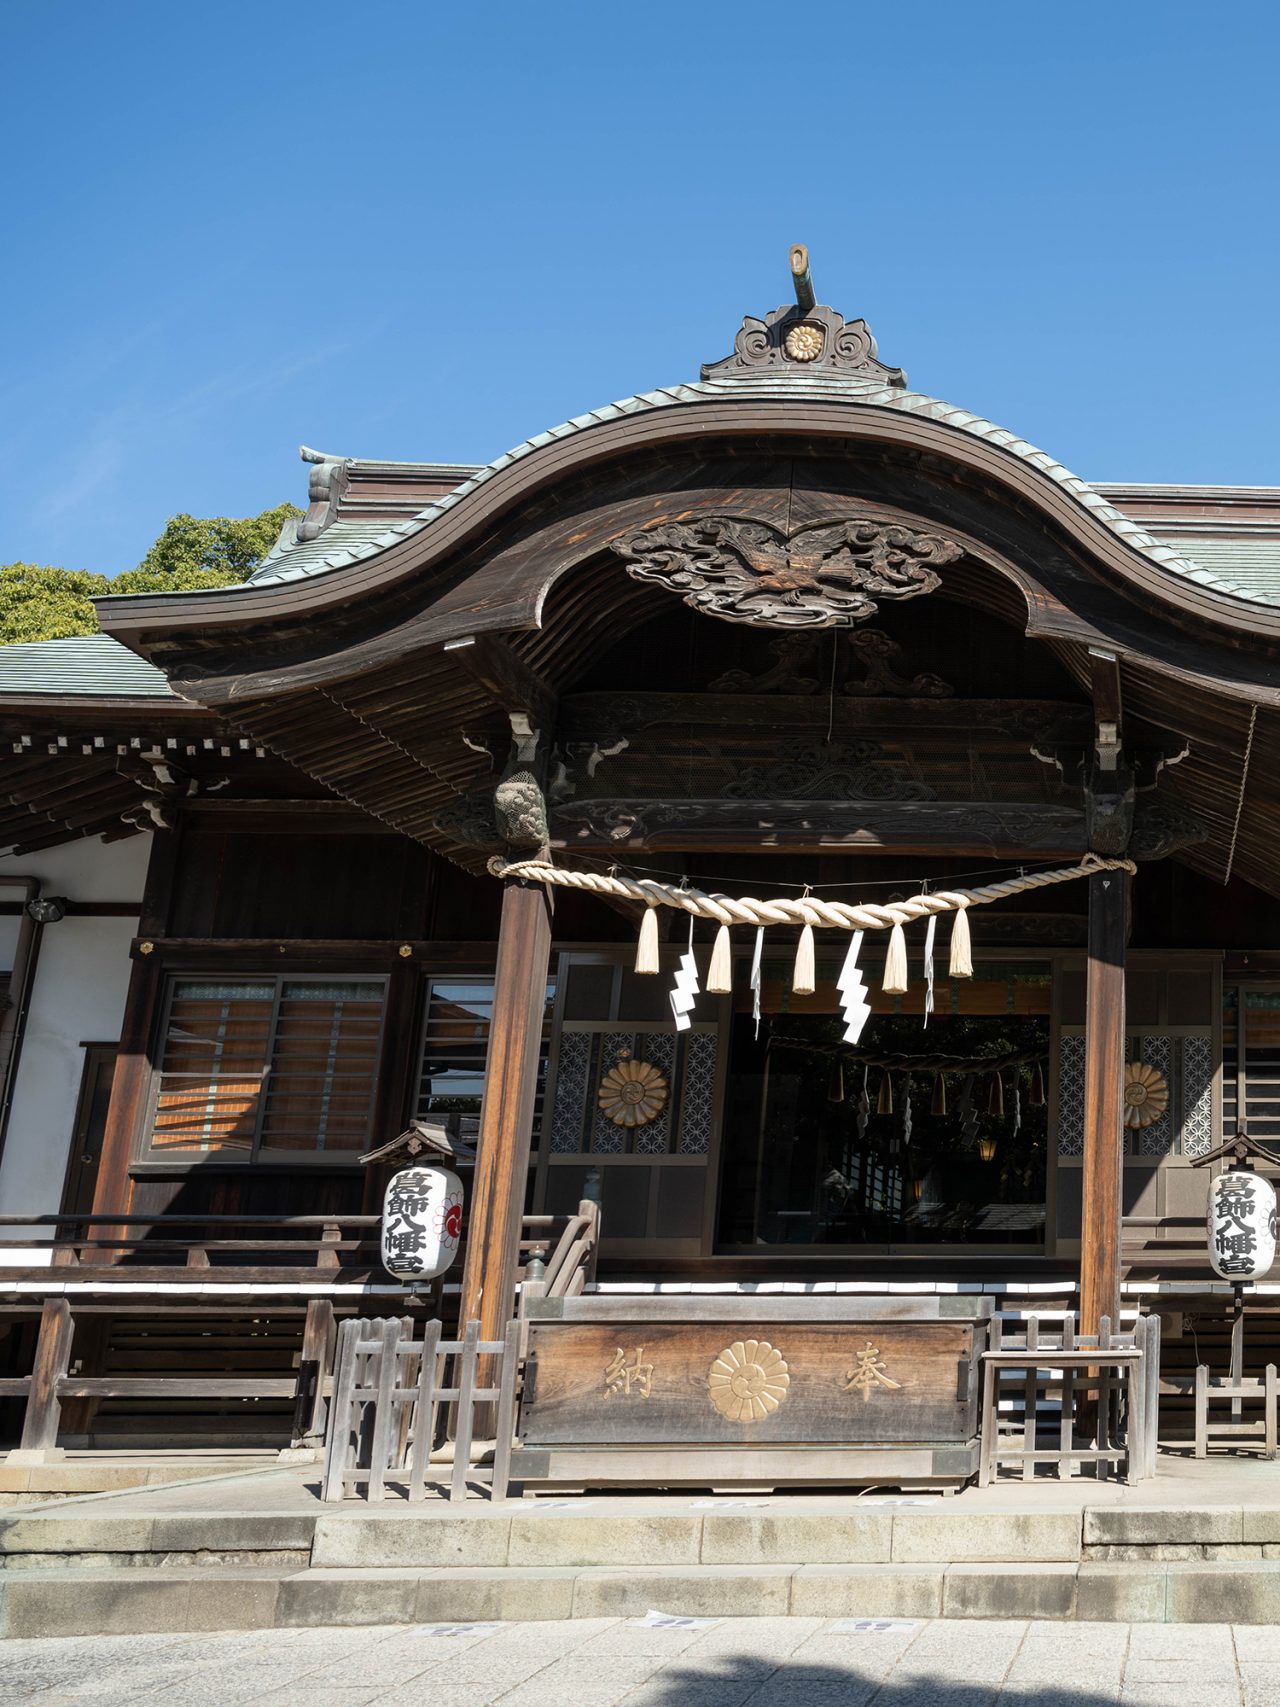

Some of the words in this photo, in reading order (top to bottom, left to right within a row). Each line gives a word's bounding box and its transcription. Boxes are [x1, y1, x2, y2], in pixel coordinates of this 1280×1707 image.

[385, 1171, 432, 1274] 葛飾八幡宮
[1215, 1175, 1257, 1275] 葛飾八幡宮
[602, 1347, 654, 1401] 納
[842, 1341, 902, 1403] 奉
